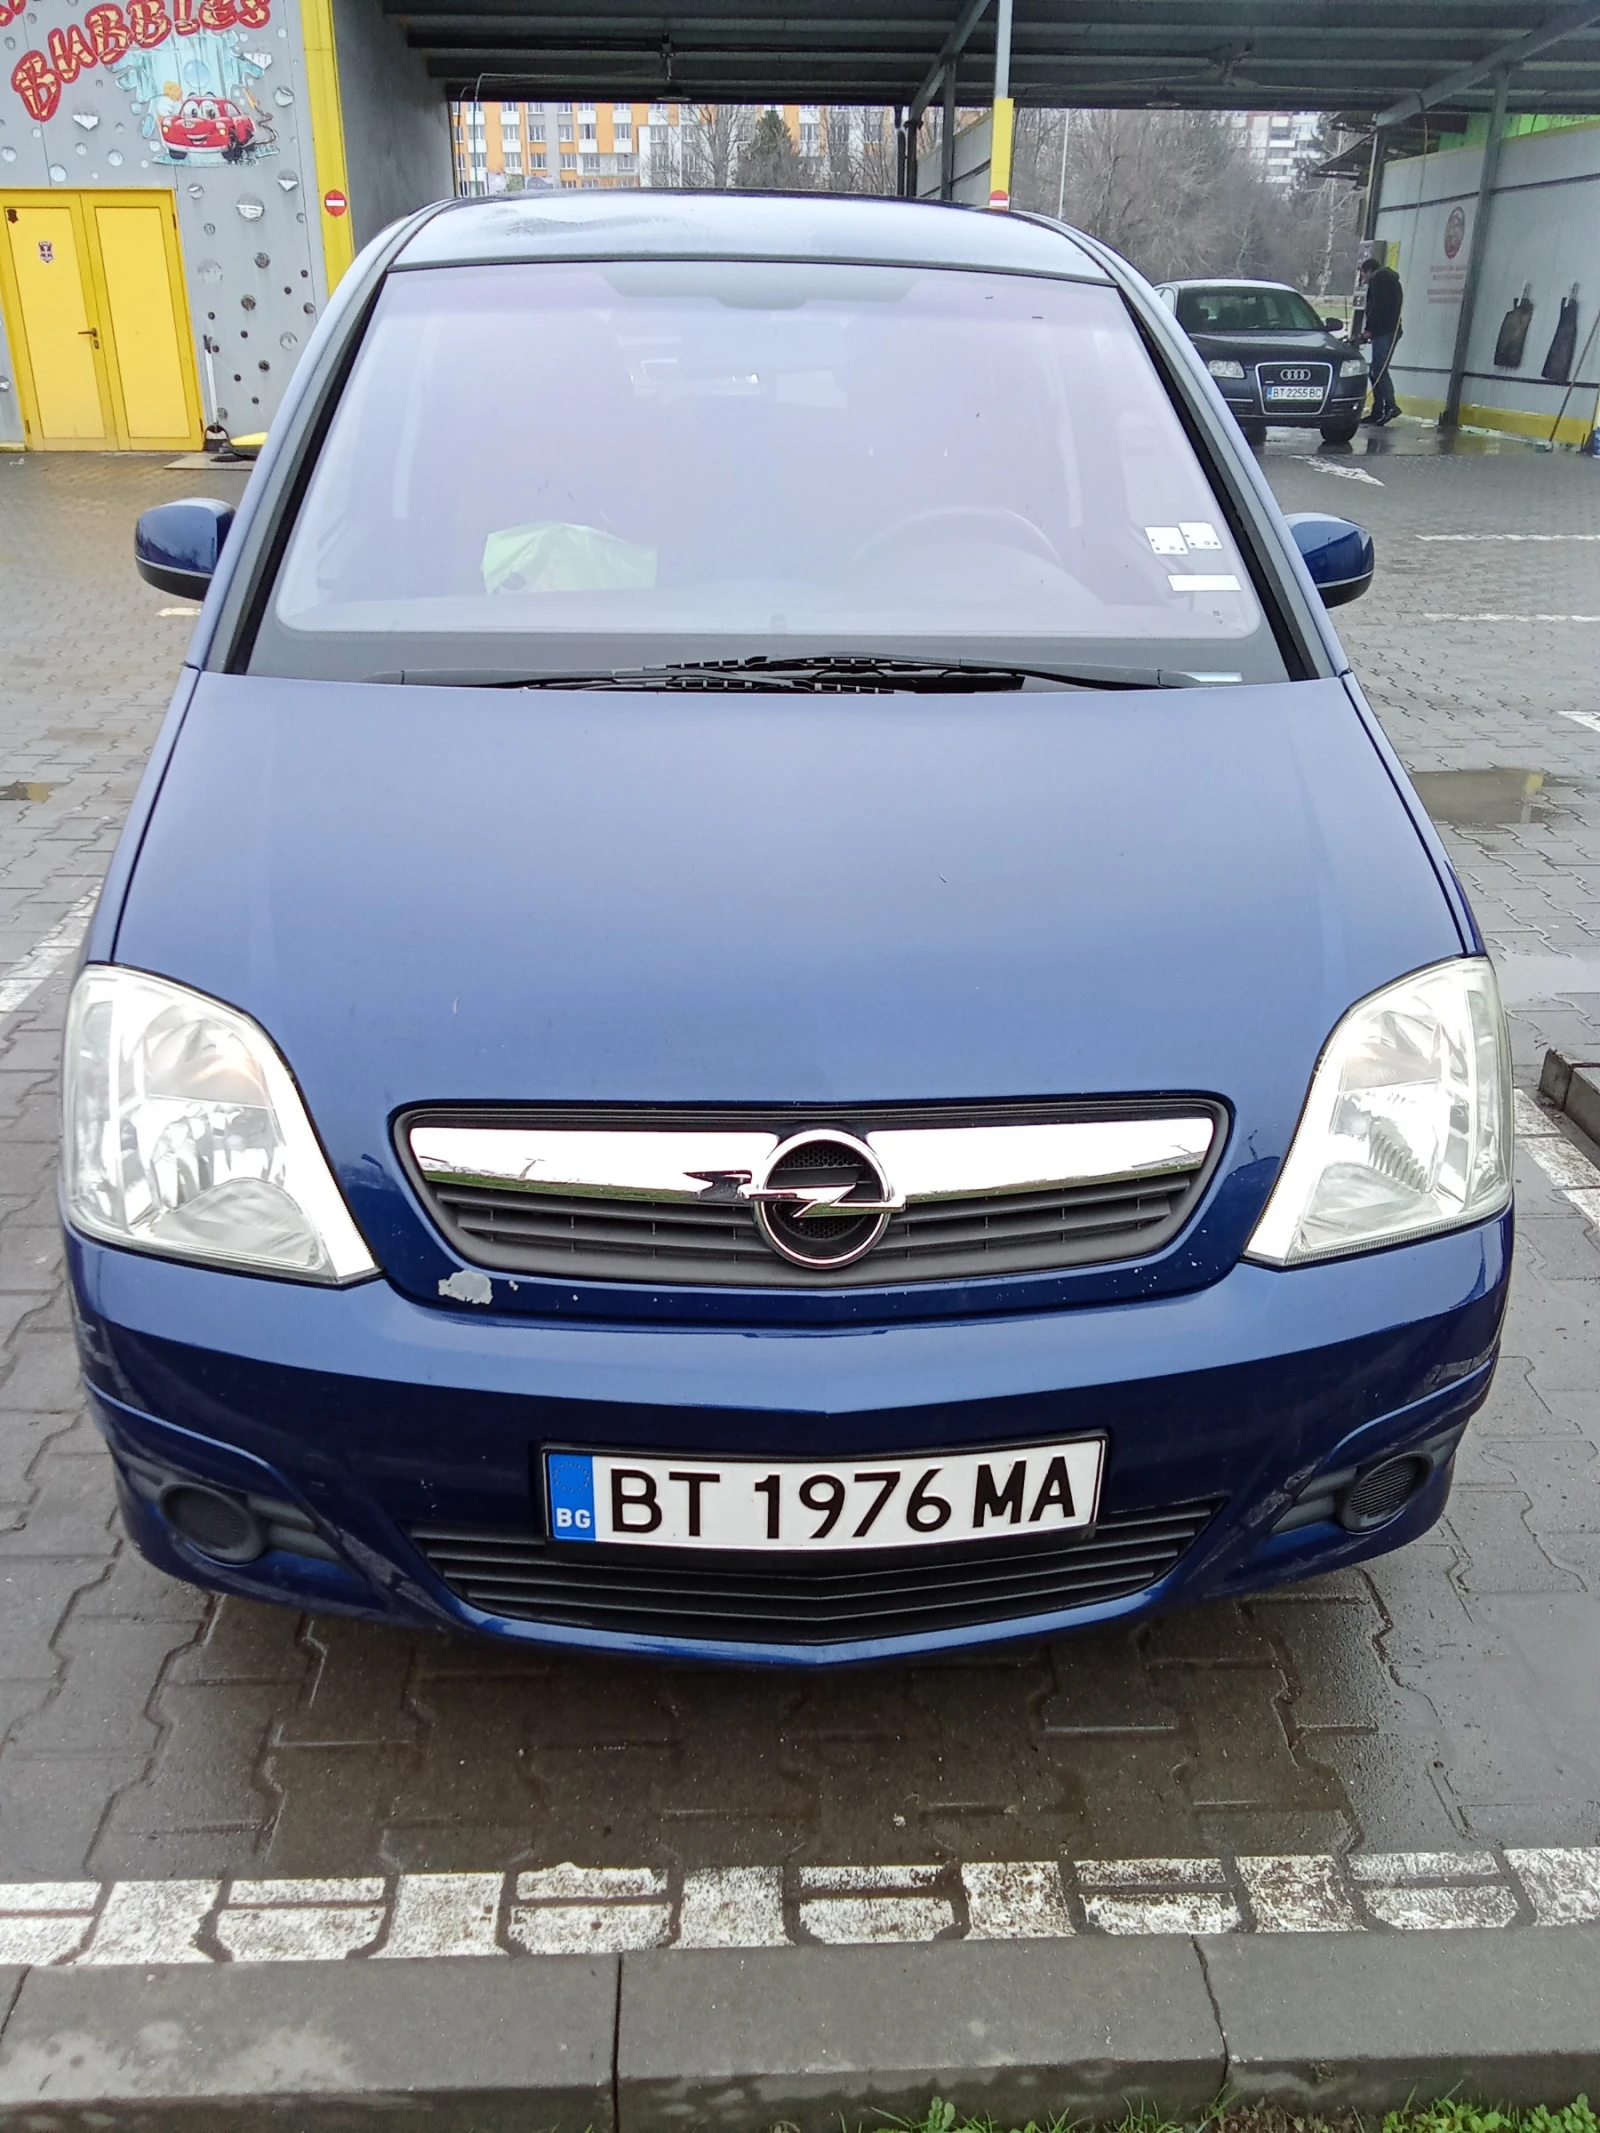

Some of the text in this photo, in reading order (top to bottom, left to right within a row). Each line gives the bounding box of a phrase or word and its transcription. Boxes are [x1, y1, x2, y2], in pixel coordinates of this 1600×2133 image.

[1273, 388, 1285, 397] BT
[1287, 388, 1308, 397] 2255
[611, 1456, 1076, 1540] BT 1976 MA
[556, 1508, 591, 1529] BG
